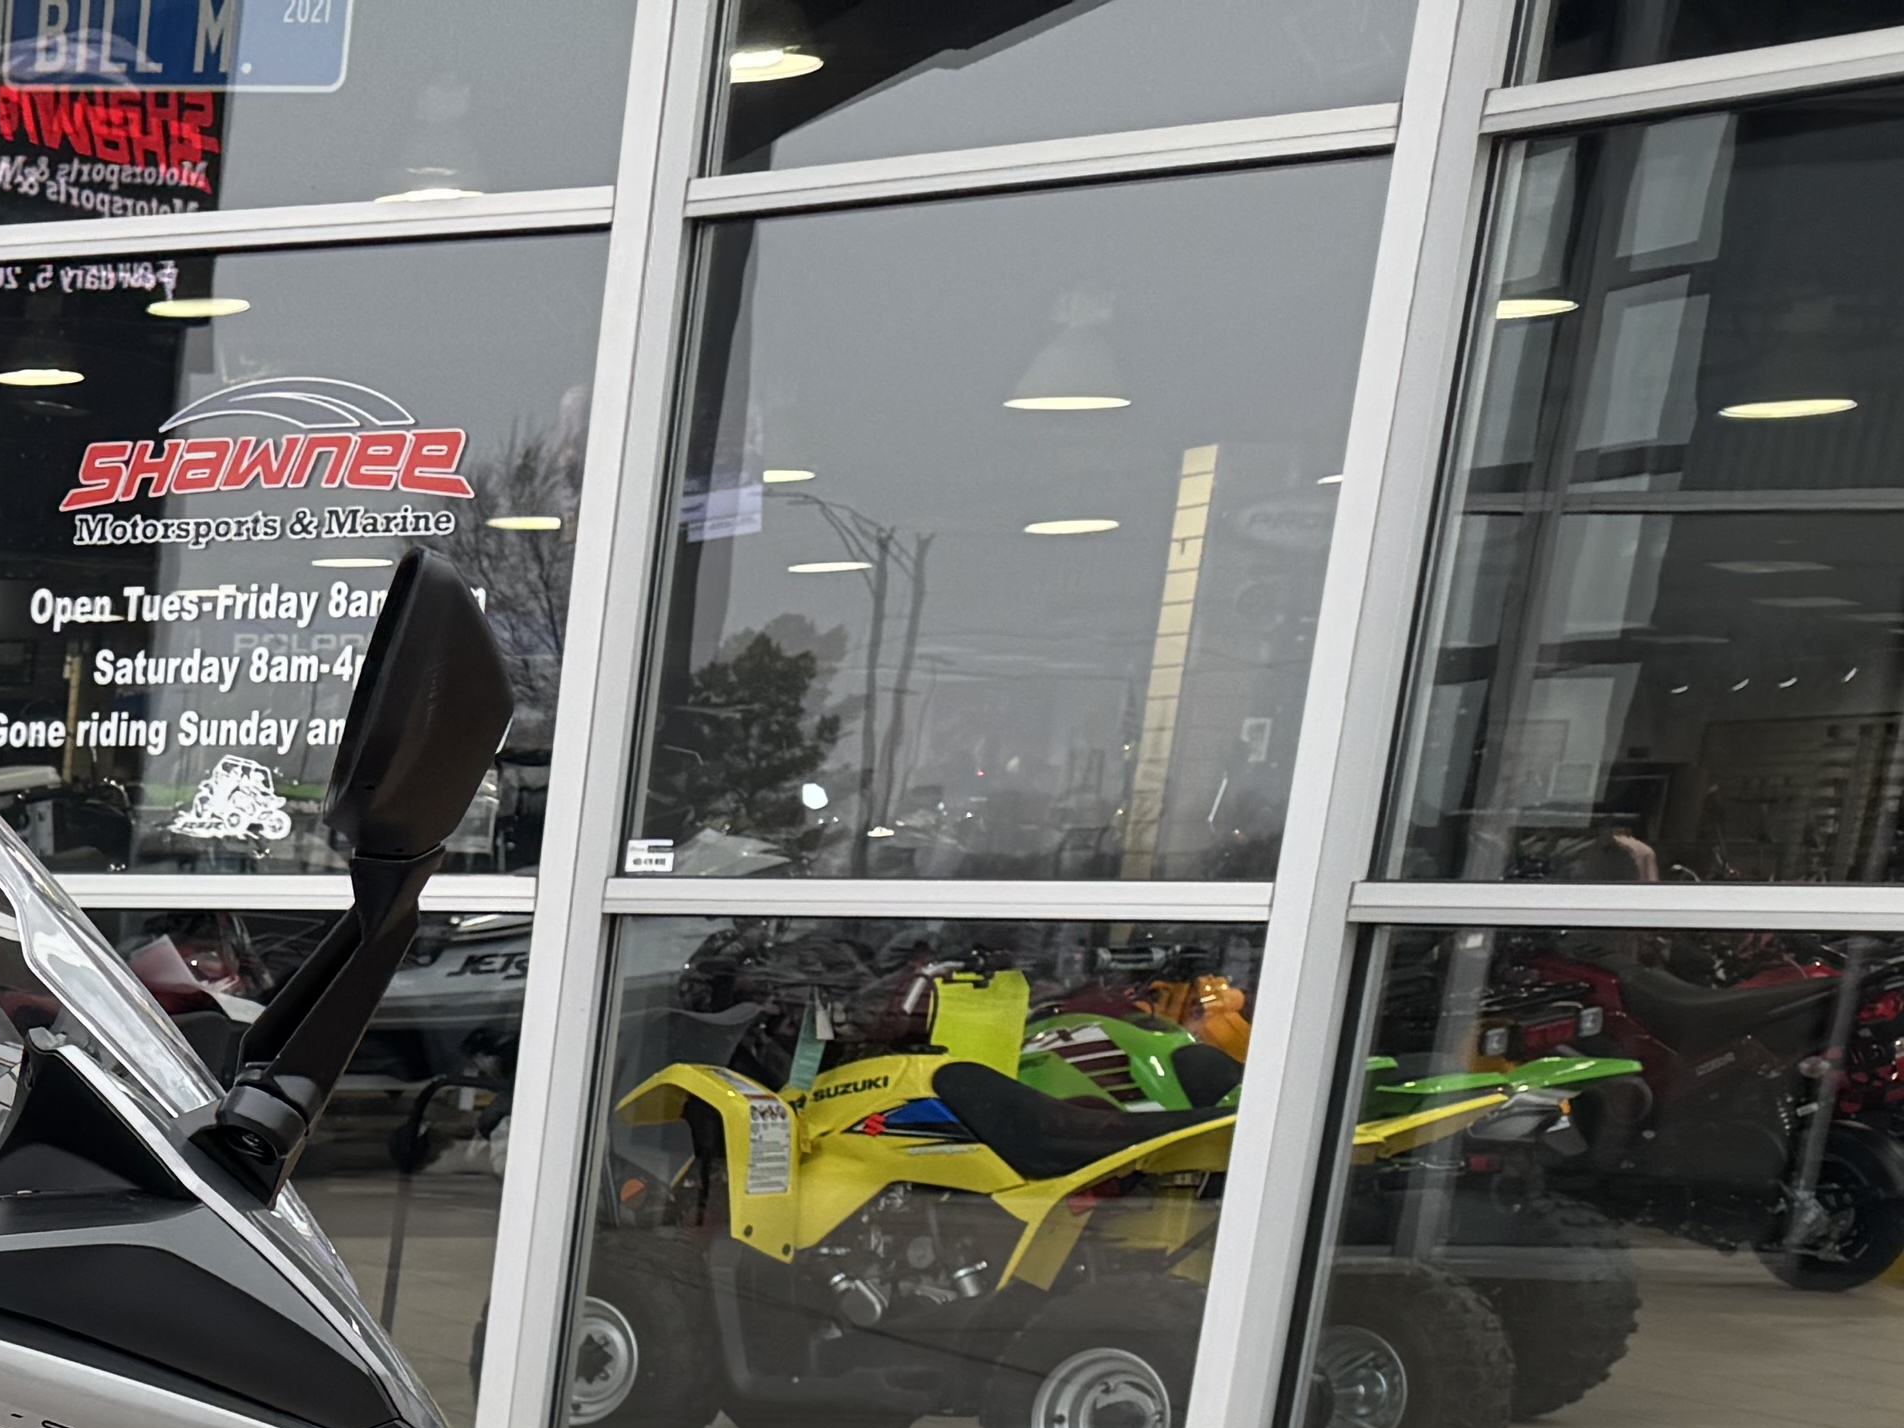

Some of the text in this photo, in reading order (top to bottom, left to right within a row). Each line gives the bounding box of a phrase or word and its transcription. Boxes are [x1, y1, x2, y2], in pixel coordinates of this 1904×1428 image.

[34, 0, 163, 73] BILL
[74, 504, 455, 549] Motorsports & Marine
[30, 587, 111, 631] Open
[123, 583, 318, 628] Tues-Friday
[93, 645, 241, 693] Saturday
[76, 711, 167, 754] riding
[177, 709, 297, 755] Sunday
[307, 718, 346, 746] an
[811, 1075, 890, 1103] SUZUKI
